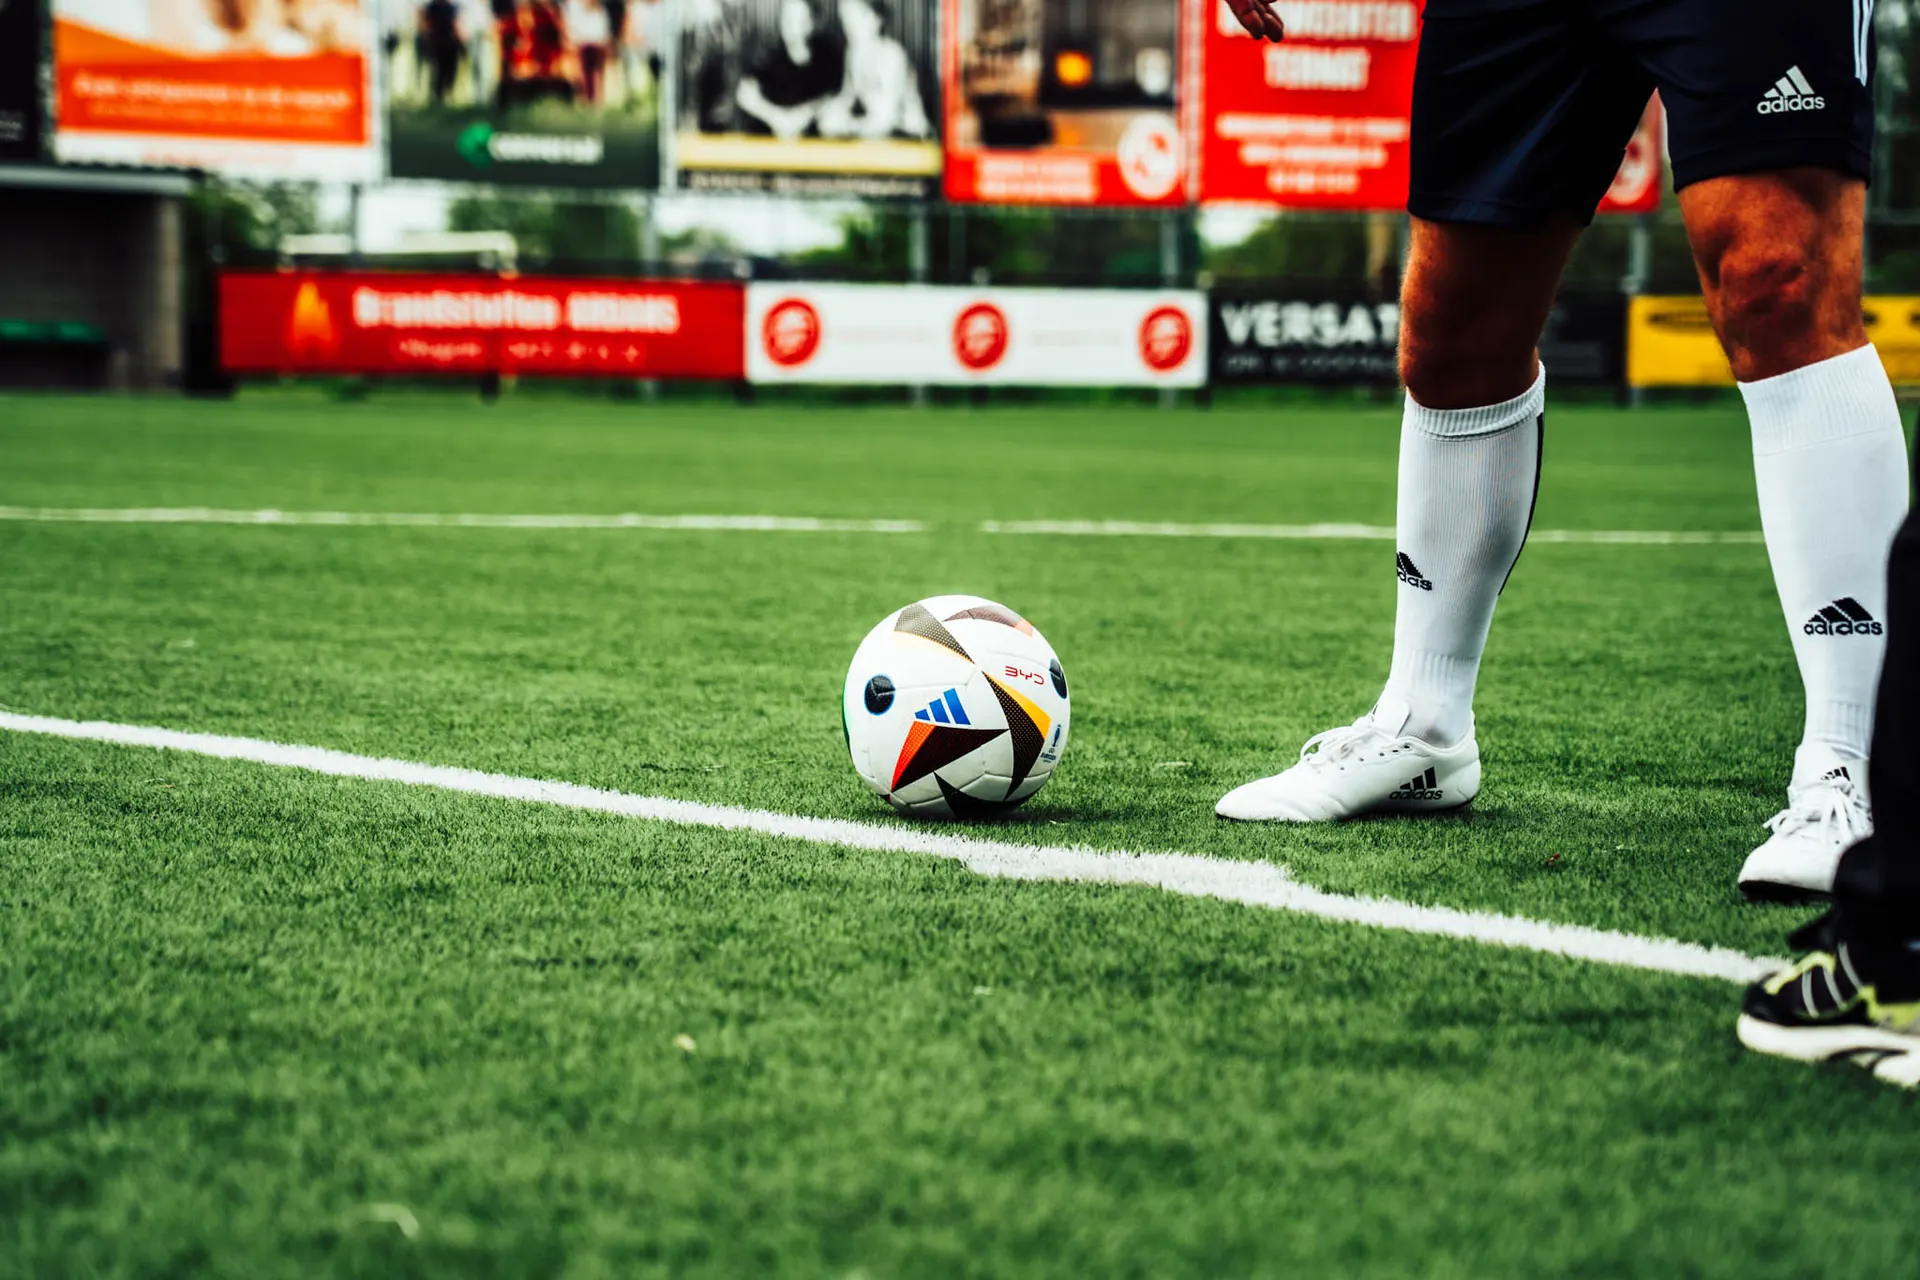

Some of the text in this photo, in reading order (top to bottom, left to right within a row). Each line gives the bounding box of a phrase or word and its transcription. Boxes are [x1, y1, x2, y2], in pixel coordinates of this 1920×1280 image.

[1757, 94, 1825, 114] adidas
[1397, 568, 1432, 591] das
[1803, 620, 1883, 636] adidas
[1005, 666, 1044, 685] BYD
[1389, 788, 1443, 800] adidas
